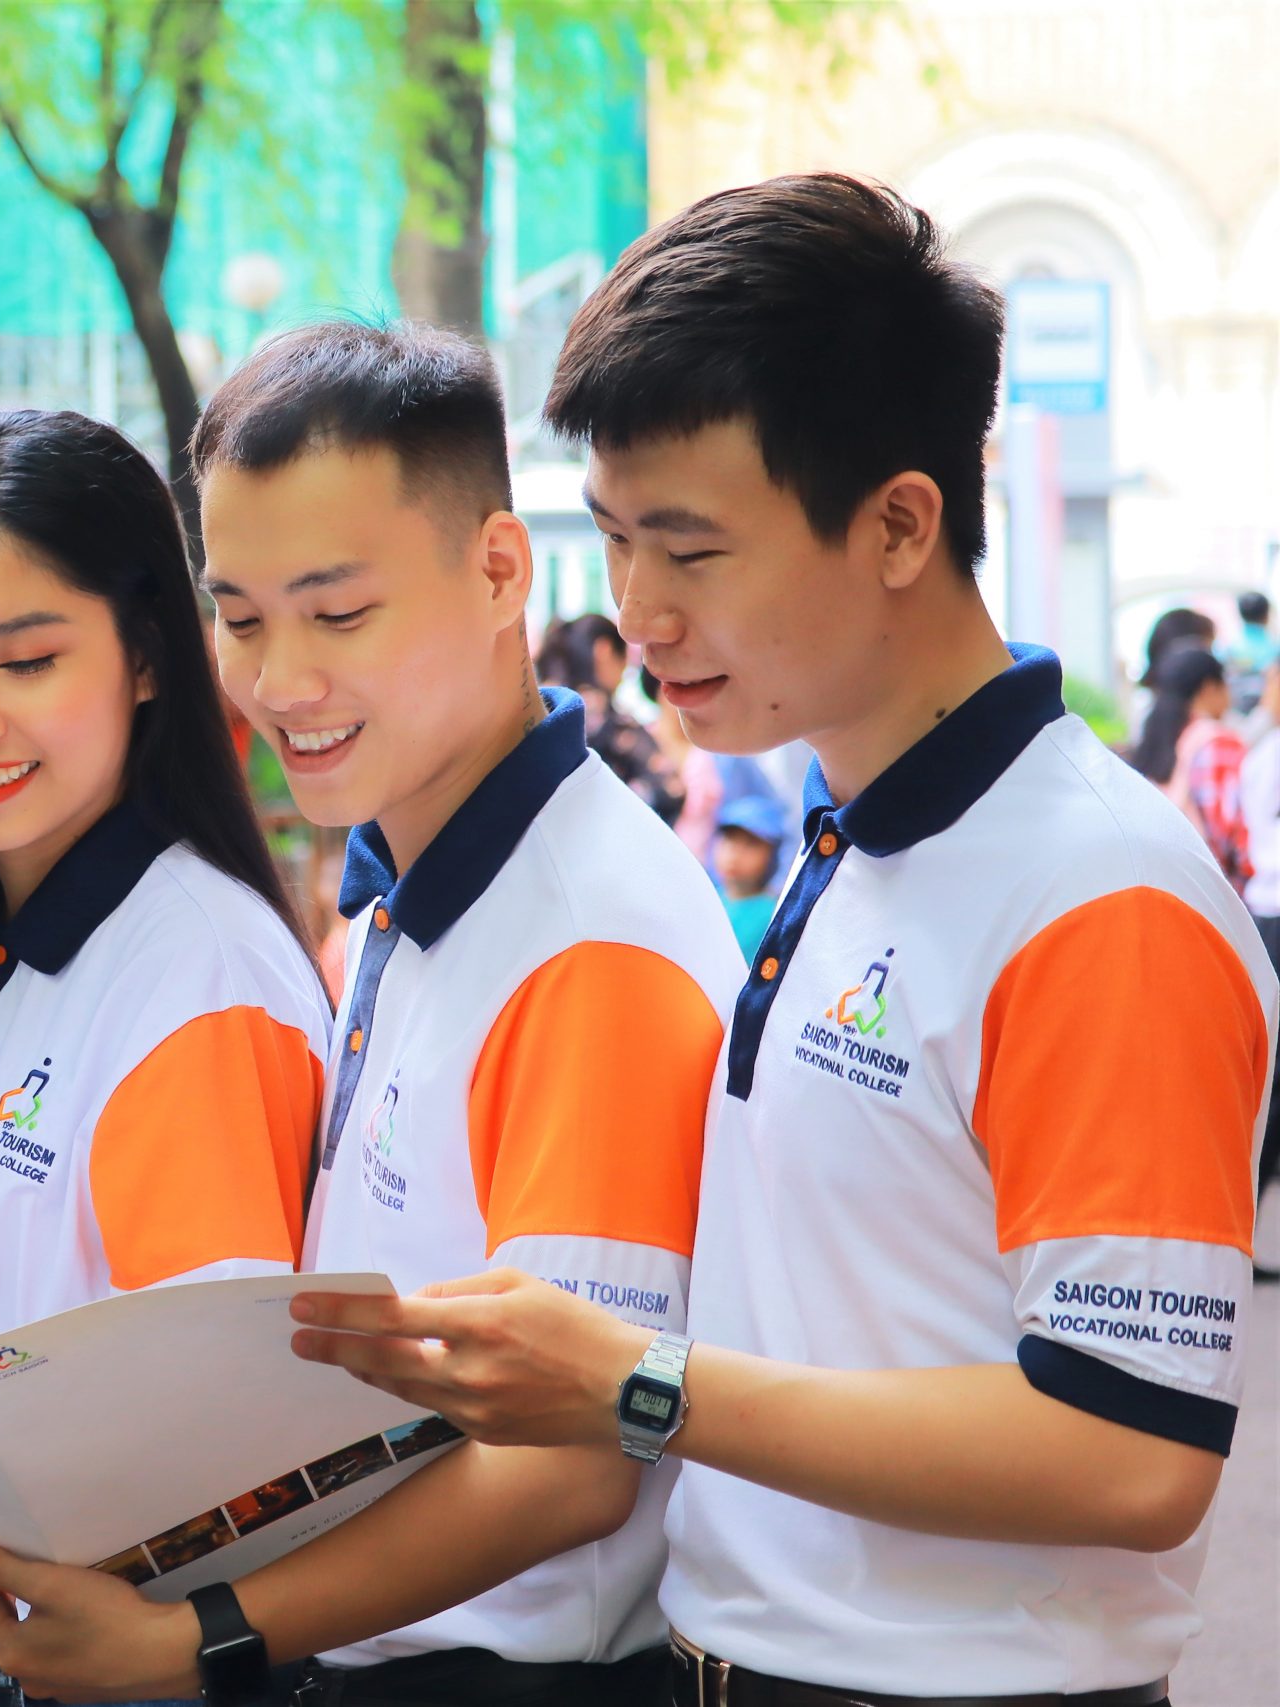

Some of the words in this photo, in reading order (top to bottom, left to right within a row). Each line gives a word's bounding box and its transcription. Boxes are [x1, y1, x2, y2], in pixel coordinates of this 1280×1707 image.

[801, 1022, 841, 1052] SAIGON
[842, 1038, 910, 1079] TOURISM
[795, 1045, 845, 1078] VOCATIONAL
[848, 1068, 903, 1098] COLLEGE
[0, 1154, 48, 1184] COLLEGE
[371, 1184, 405, 1213] COLLEGE
[586, 1280, 670, 1315] TOURISM
[1054, 1280, 1142, 1312] SAIGON
[1149, 1290, 1236, 1323] TOURISM
[1049, 1313, 1163, 1343] VOCATIONAL
[1168, 1327, 1233, 1352] COLLEGE
